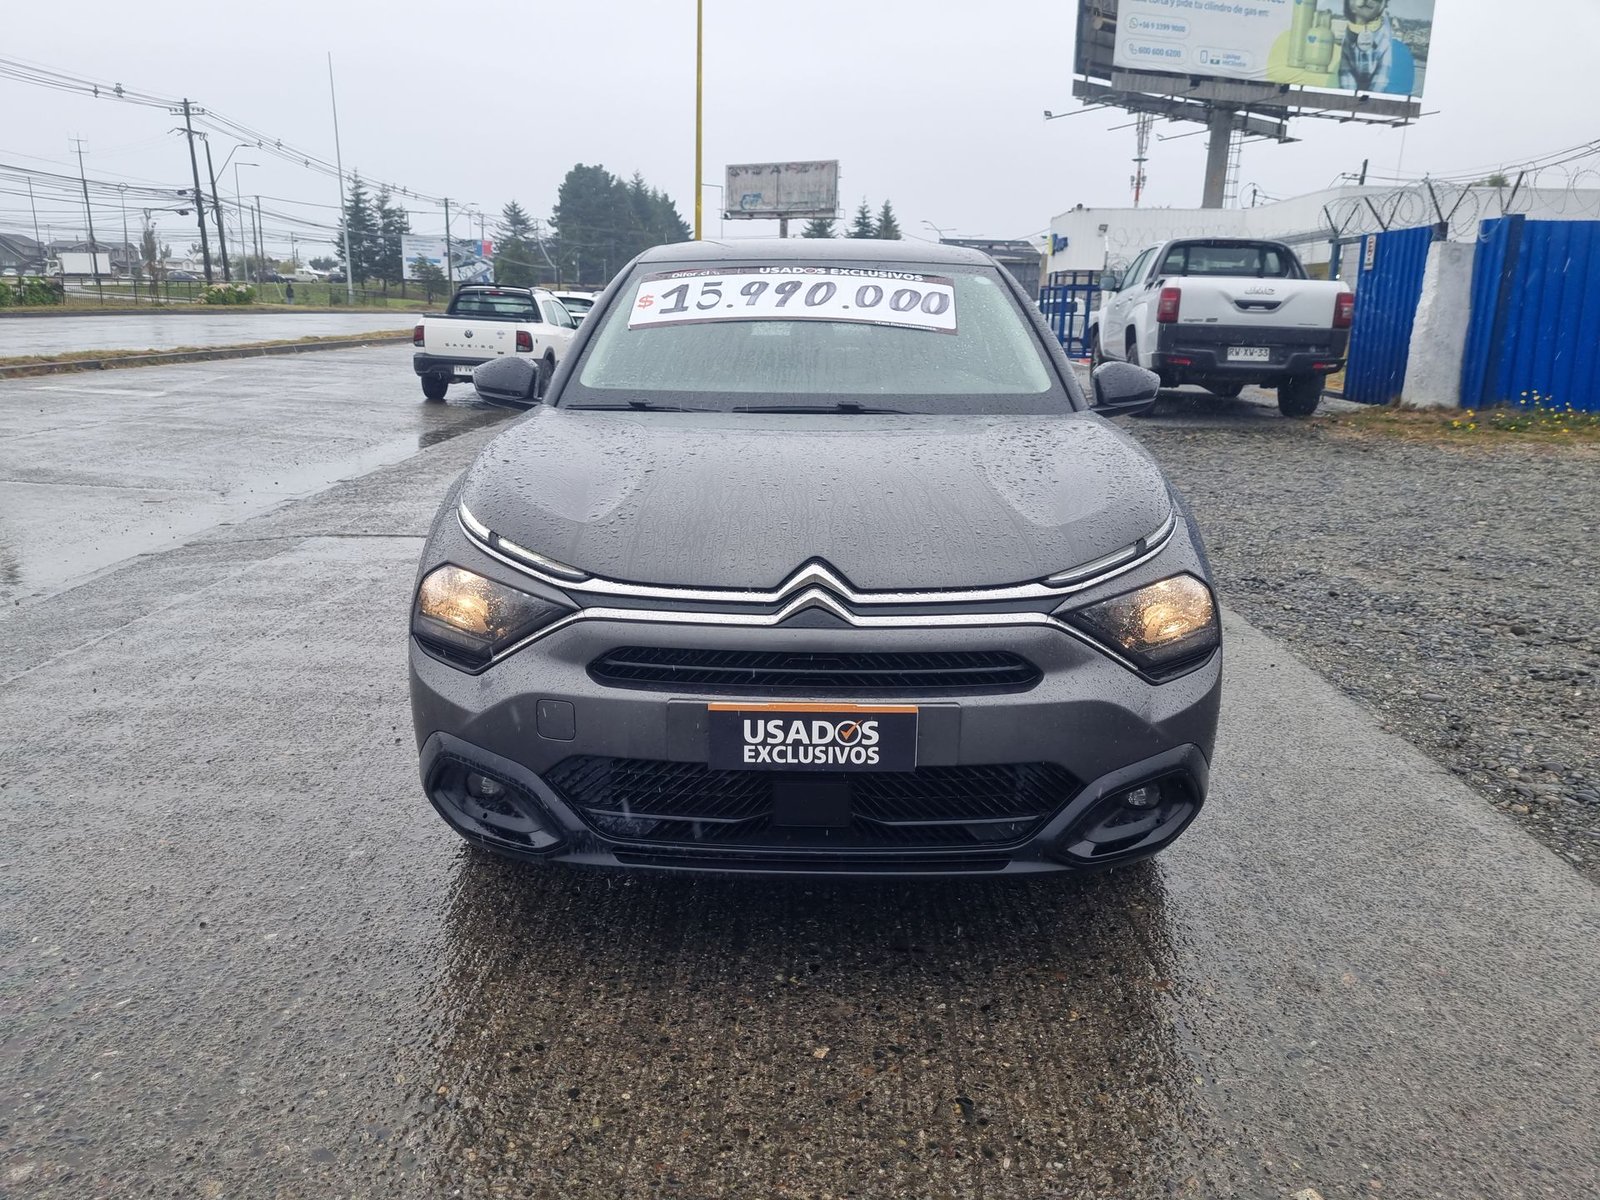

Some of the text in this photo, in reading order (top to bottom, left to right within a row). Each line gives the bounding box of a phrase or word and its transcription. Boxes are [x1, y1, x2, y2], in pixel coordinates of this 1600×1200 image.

[1194, 1, 1203, 9] tu
[1204, 2, 1232, 13] cilindro
[1233, 5, 1242, 14] de
[1244, 7, 1257, 16] gas
[759, 266, 924, 282] USADOS EXCLUSIVOS
[637, 281, 950, 316] $ 15.990.000
[743, 719, 880, 746] USADOS
[743, 746, 880, 765] EXCLUSIVOS
